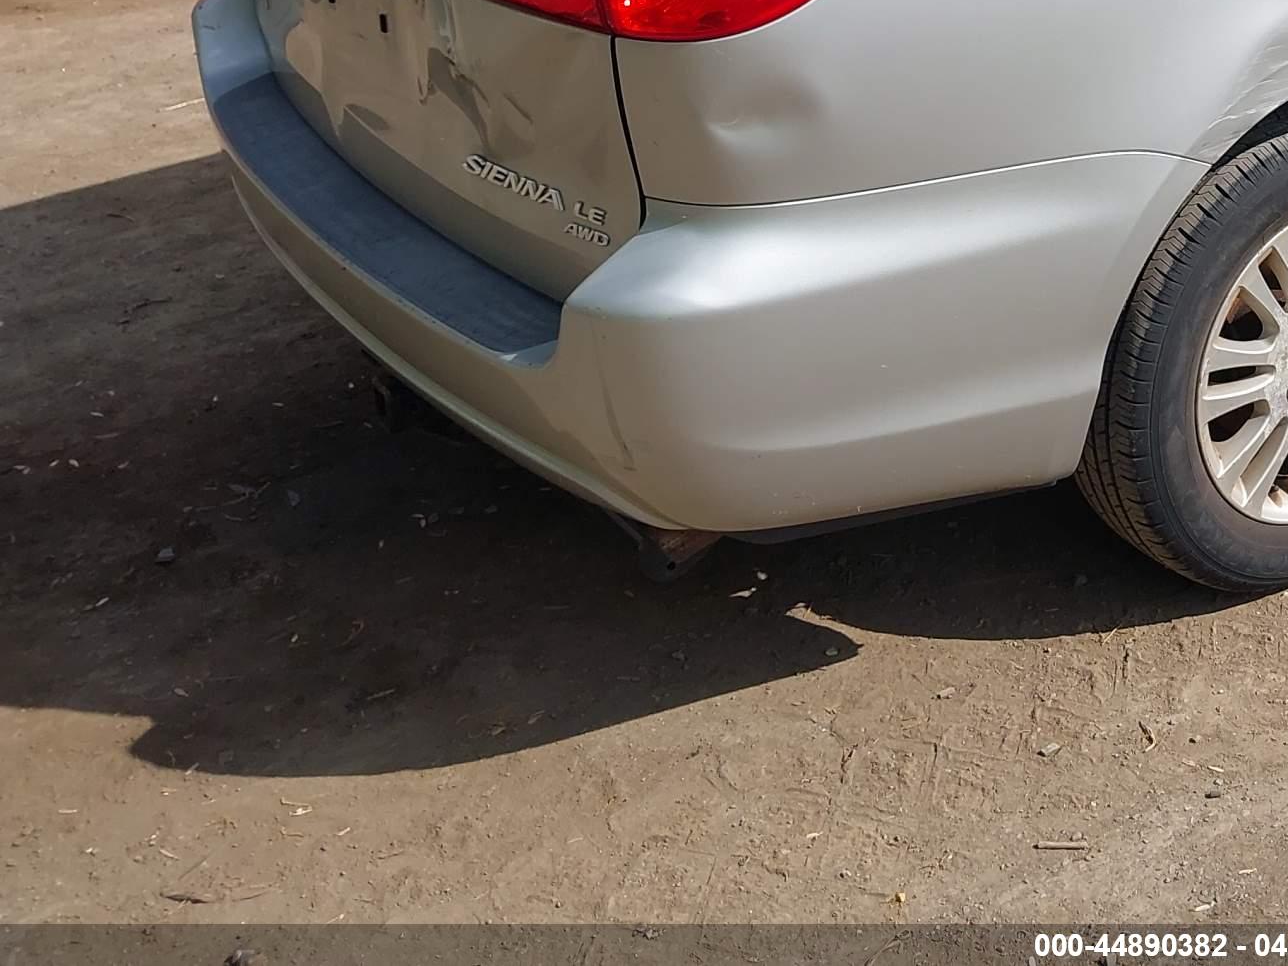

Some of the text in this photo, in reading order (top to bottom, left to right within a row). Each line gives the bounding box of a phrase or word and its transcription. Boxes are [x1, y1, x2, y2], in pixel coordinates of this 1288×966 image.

[462, 154, 607, 226] SIENNA LE
[564, 222, 611, 247] AWD
